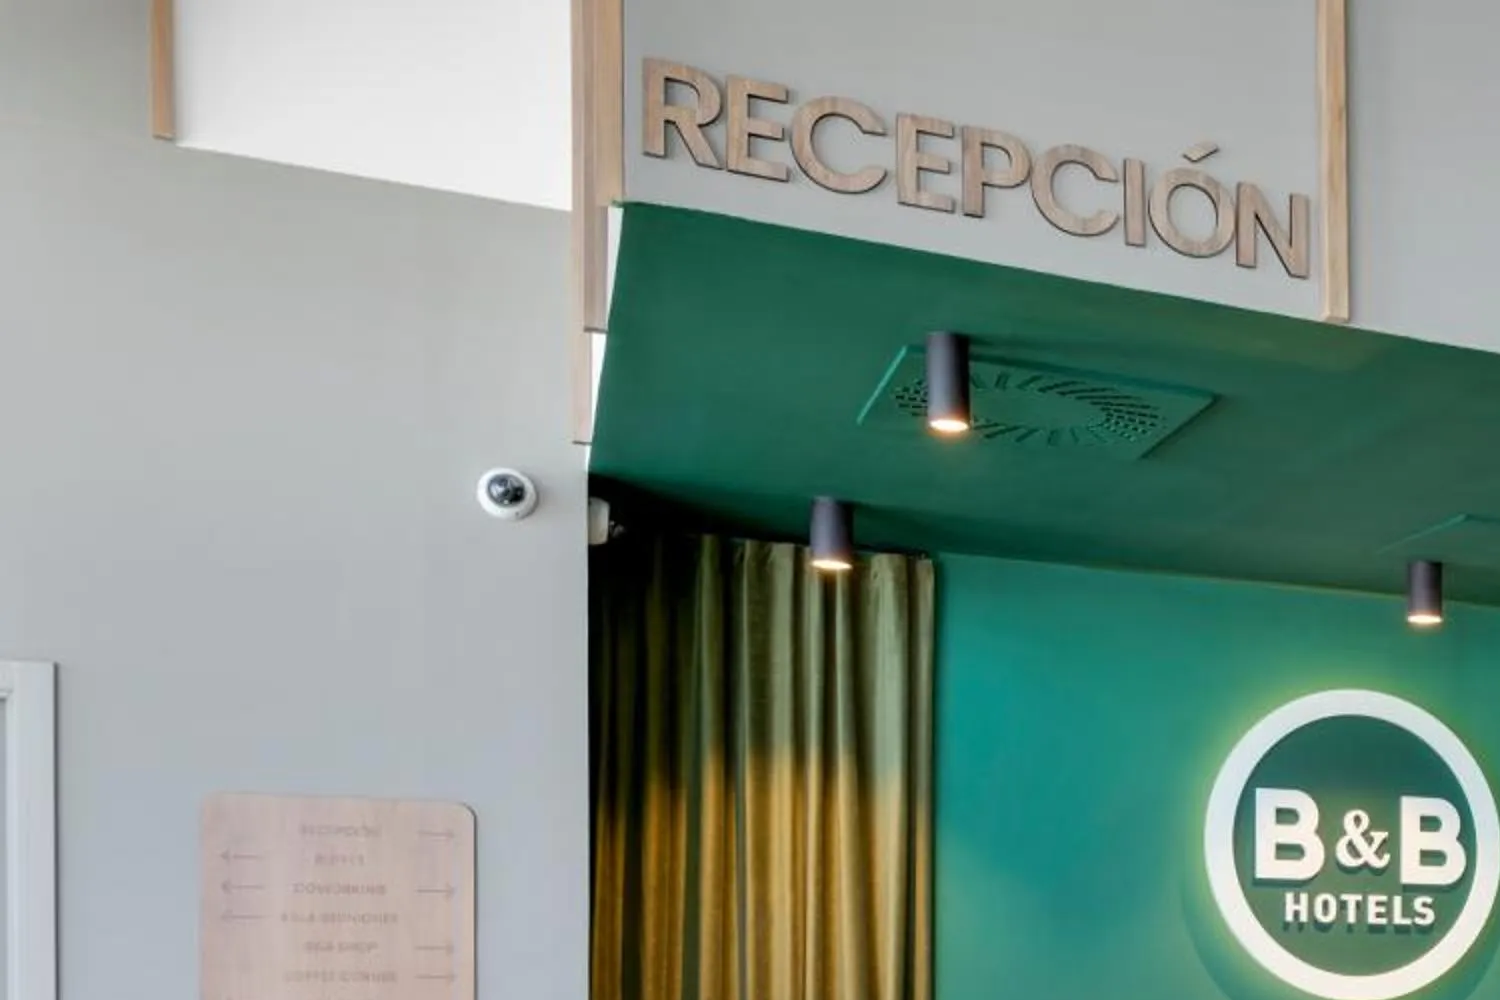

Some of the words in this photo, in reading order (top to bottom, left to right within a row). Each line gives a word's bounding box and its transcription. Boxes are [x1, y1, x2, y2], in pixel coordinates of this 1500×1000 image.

[641, 56, 1310, 280] RECEPCIÓN
[1255, 787, 1467, 887] B&B
[1284, 892, 1436, 926] HOTELS
